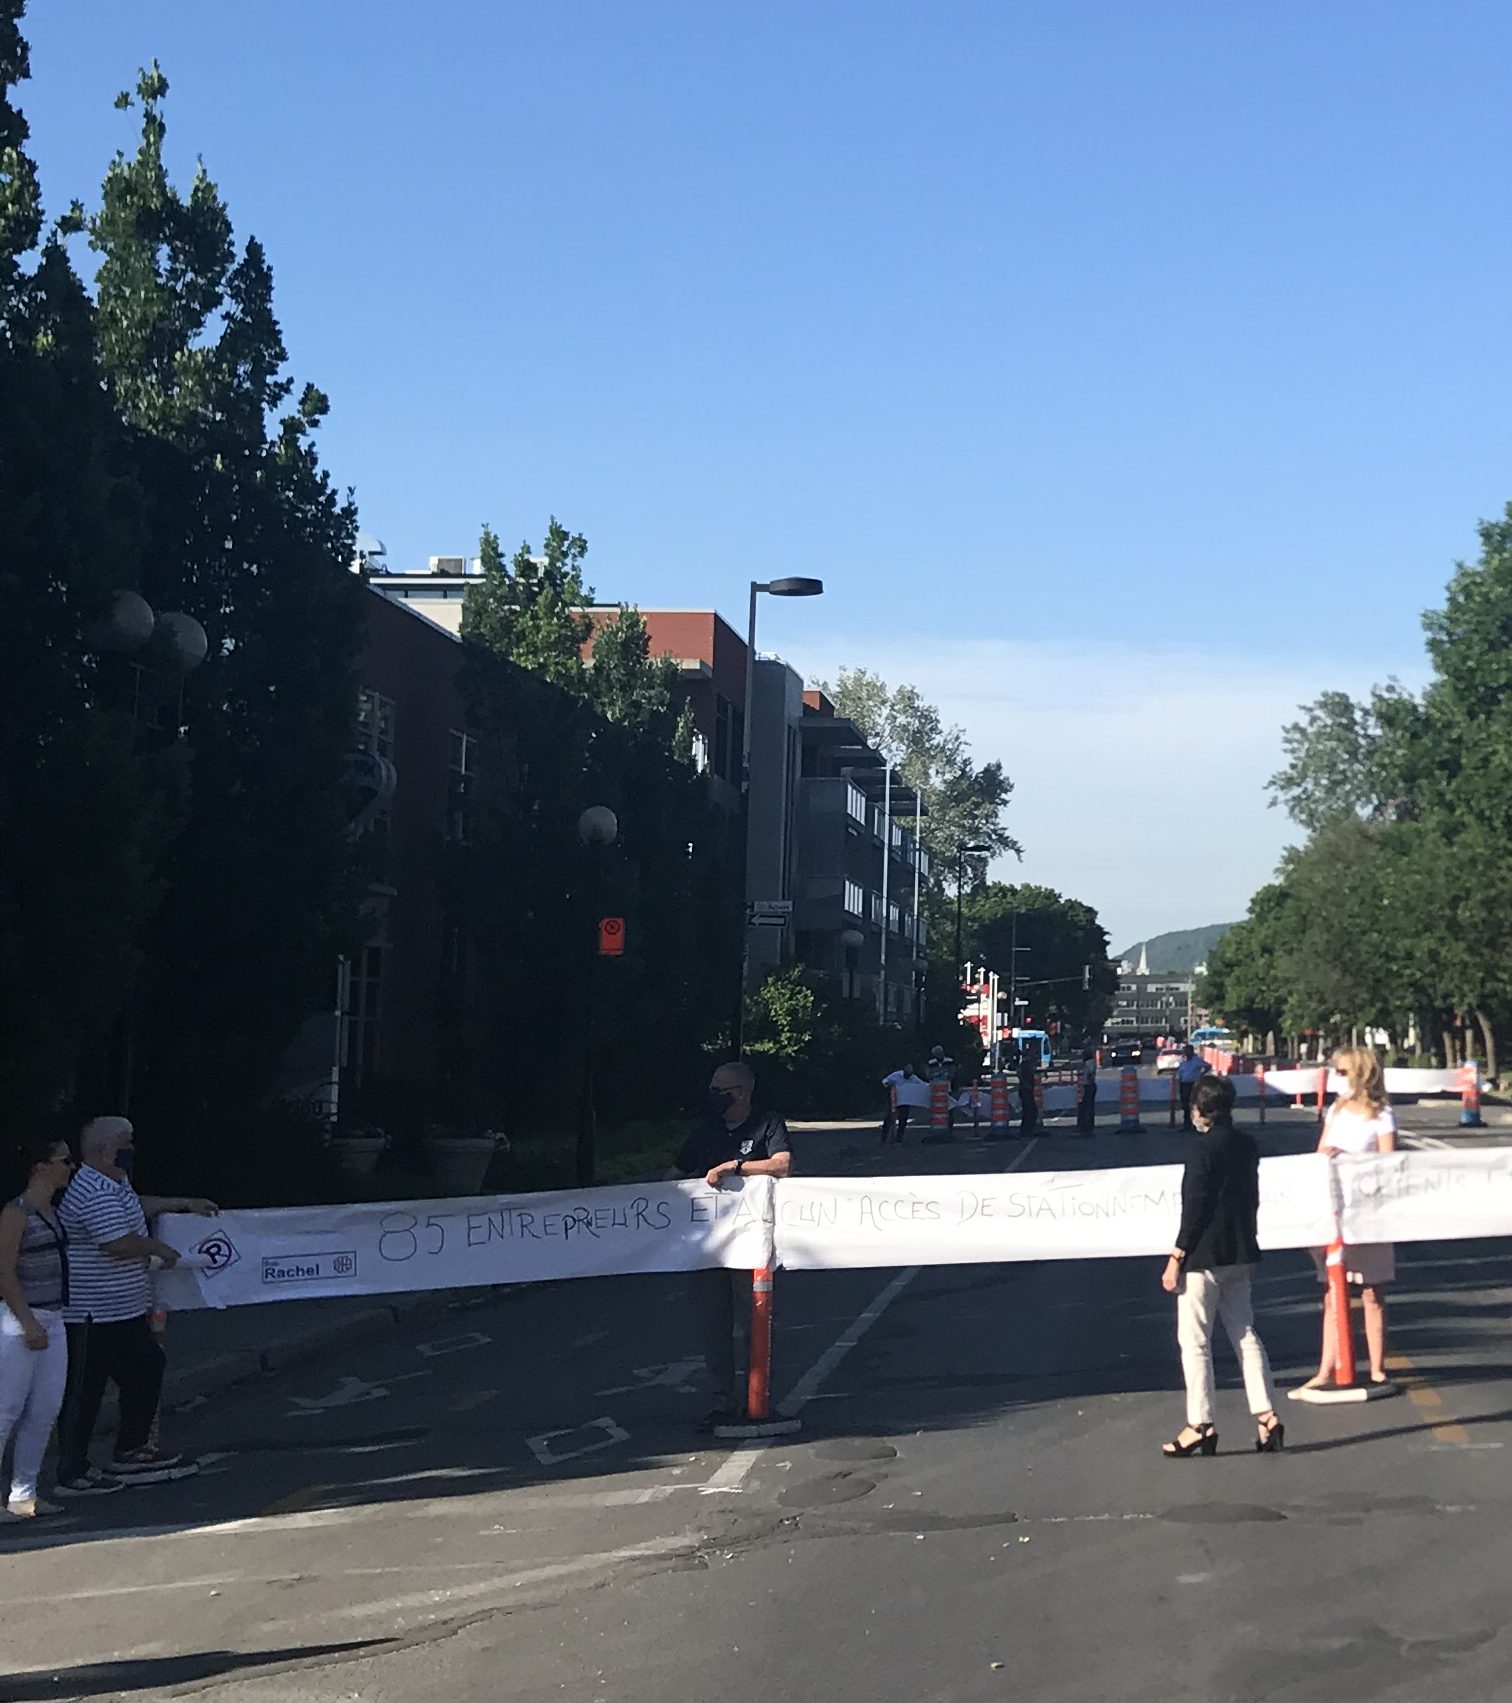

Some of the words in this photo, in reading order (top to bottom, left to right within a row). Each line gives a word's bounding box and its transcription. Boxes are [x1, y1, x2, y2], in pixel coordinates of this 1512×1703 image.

[378, 1212, 453, 1262] 85
[690, 1192, 731, 1223] ET
[732, 1198, 838, 1227] ACUN
[859, 1192, 942, 1231] ACCÈS
[955, 1190, 997, 1226] DE
[264, 1264, 320, 1279] Rachel
